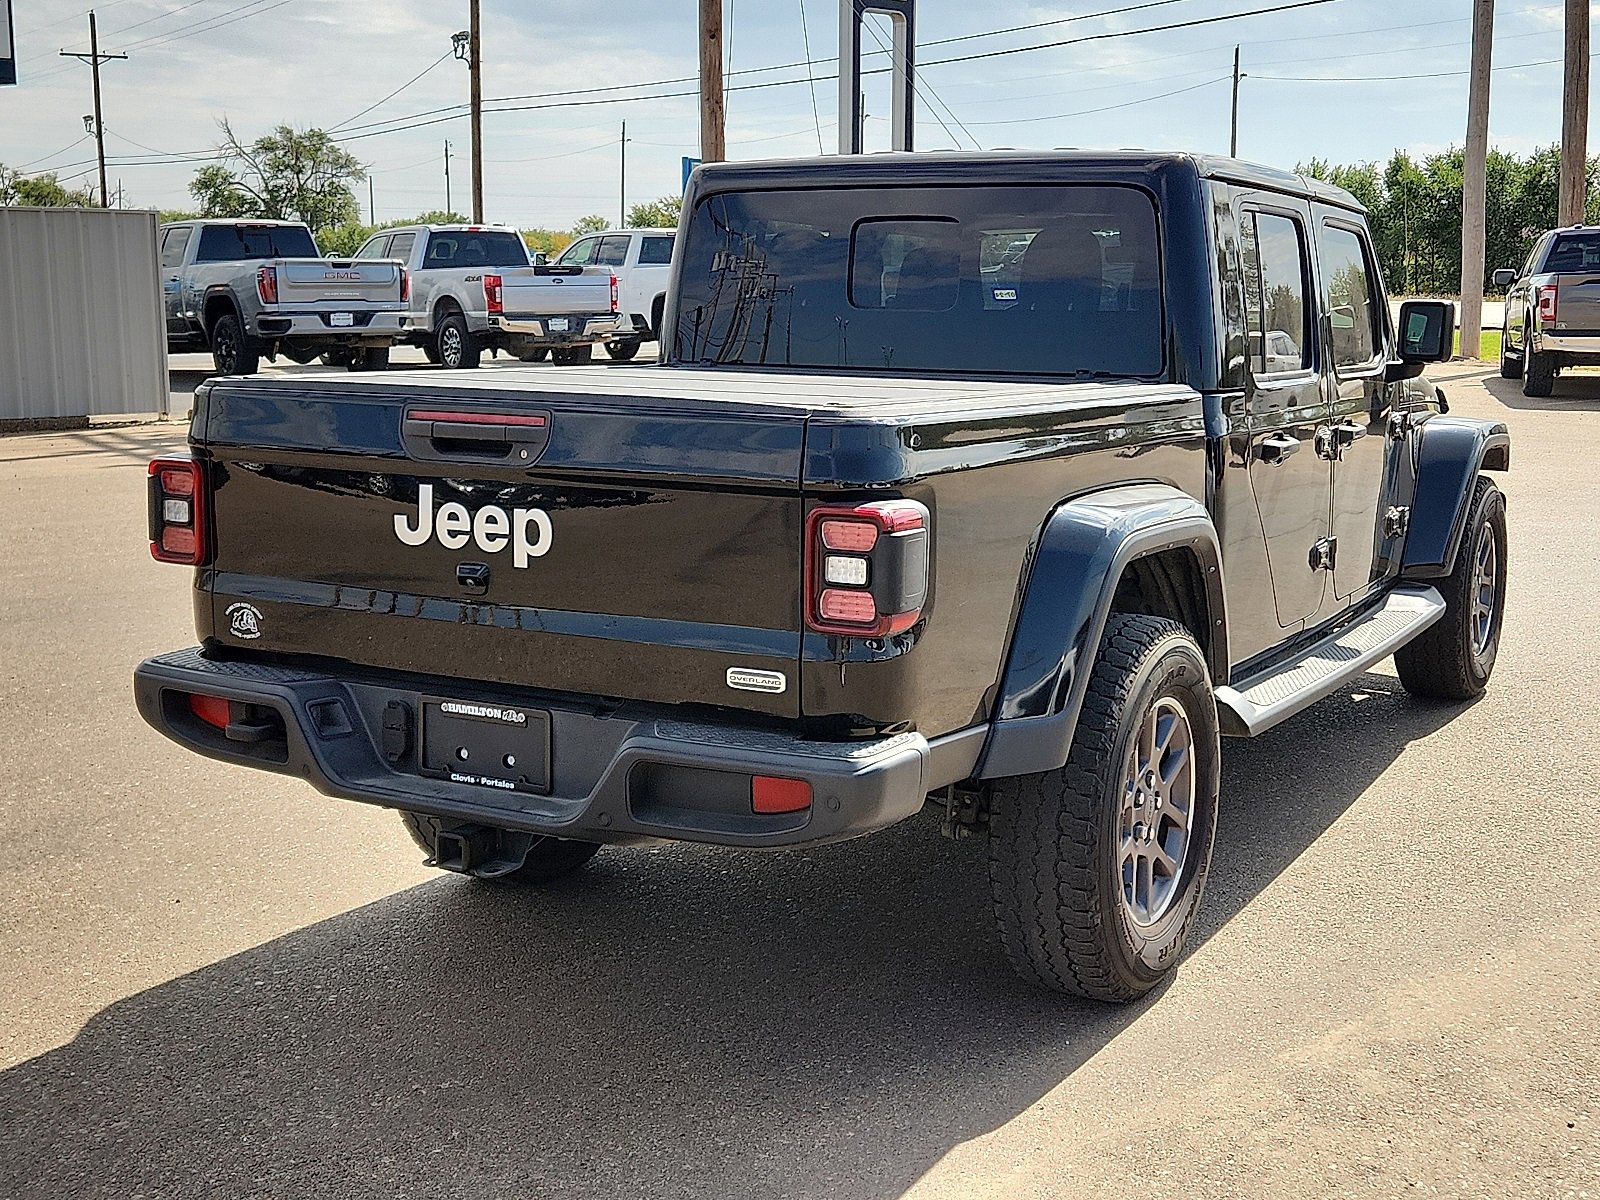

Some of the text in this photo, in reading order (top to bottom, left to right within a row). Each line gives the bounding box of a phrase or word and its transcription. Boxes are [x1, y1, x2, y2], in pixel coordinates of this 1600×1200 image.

[323, 272, 361, 280] GMC
[394, 484, 553, 569] Jeep
[729, 675, 782, 686] OVERLAND
[447, 702, 502, 720] HAMILTON
[450, 773, 515, 789] Clovis Portales
